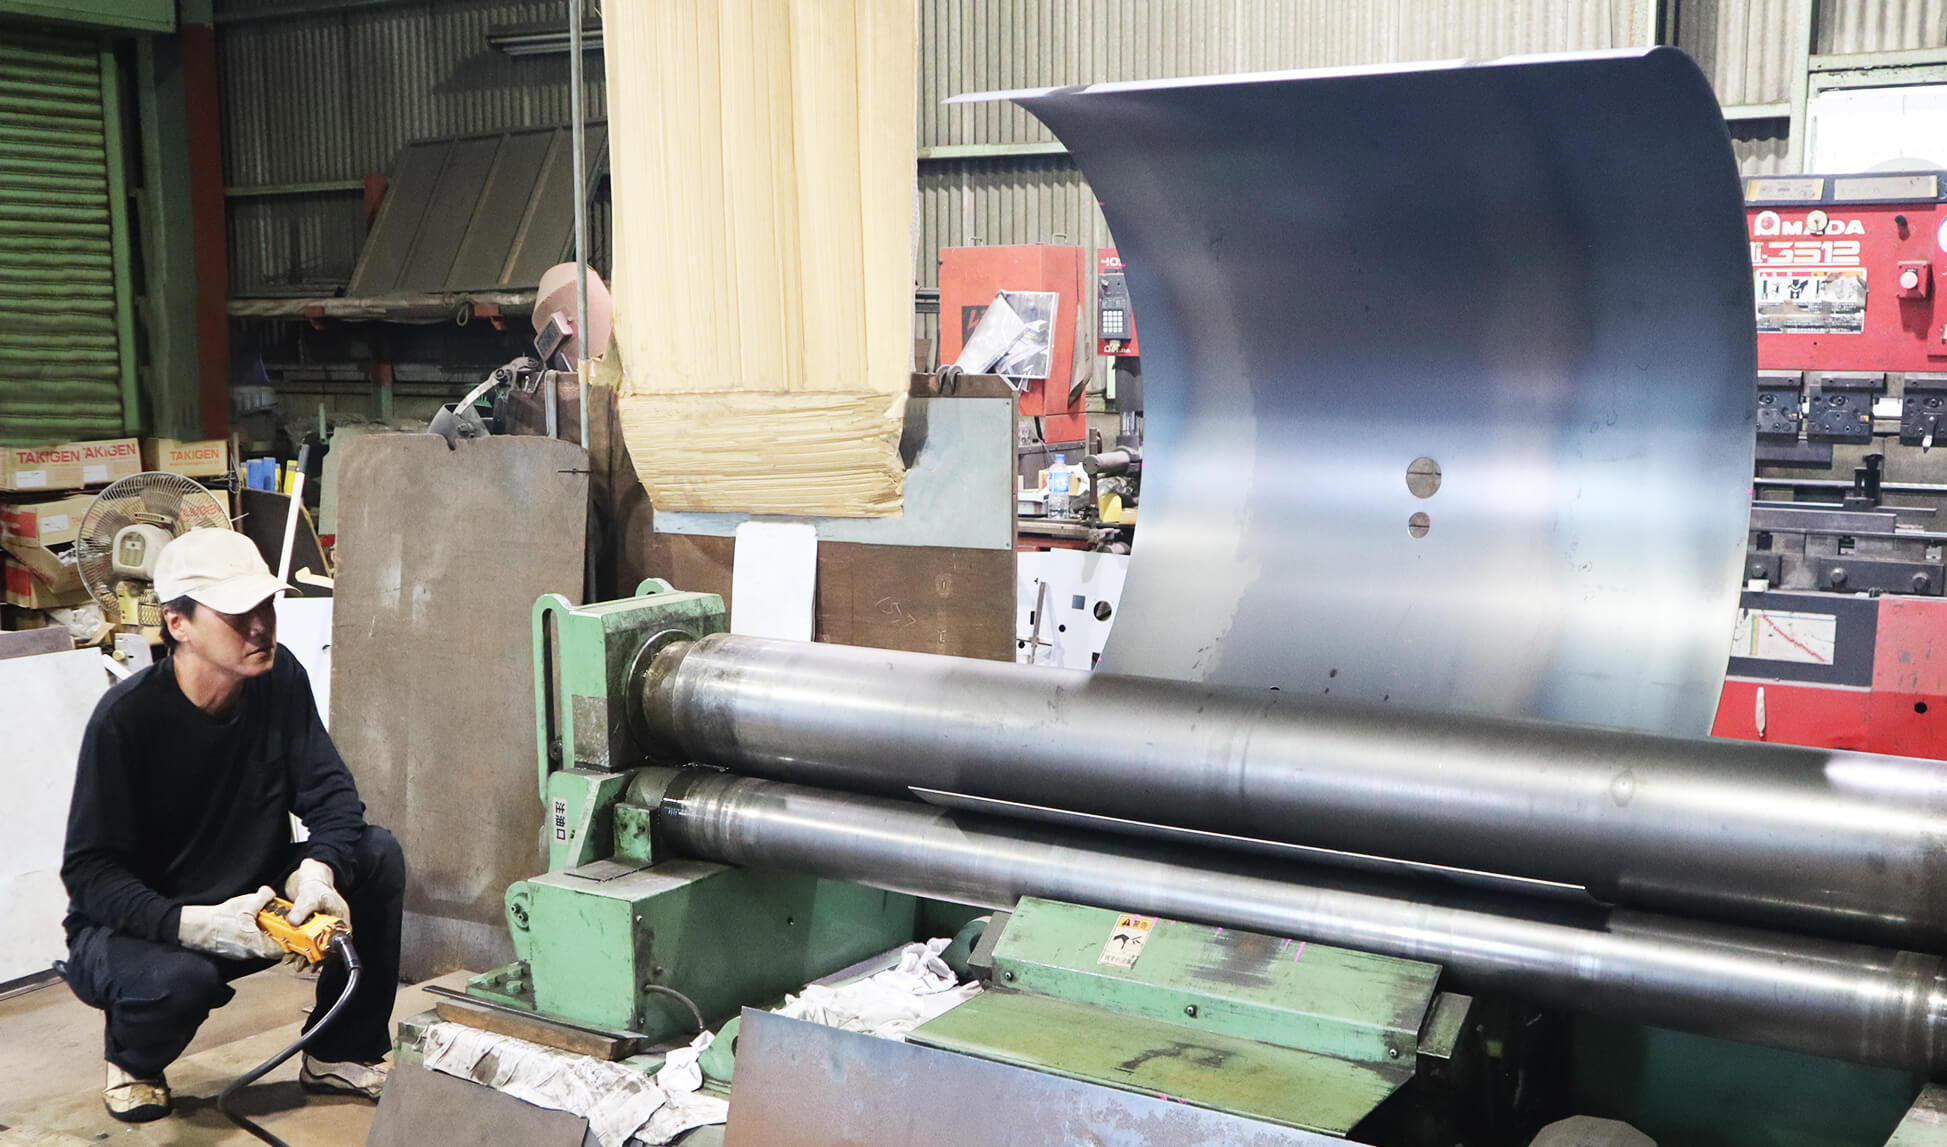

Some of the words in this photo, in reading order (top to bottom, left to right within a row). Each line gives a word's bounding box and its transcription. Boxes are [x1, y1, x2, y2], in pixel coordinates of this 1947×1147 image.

[16, 450, 80, 464] TAKIGEN
[83, 443, 136, 459] AKIGEN
[168, 449, 220, 461] TAKIGEN
